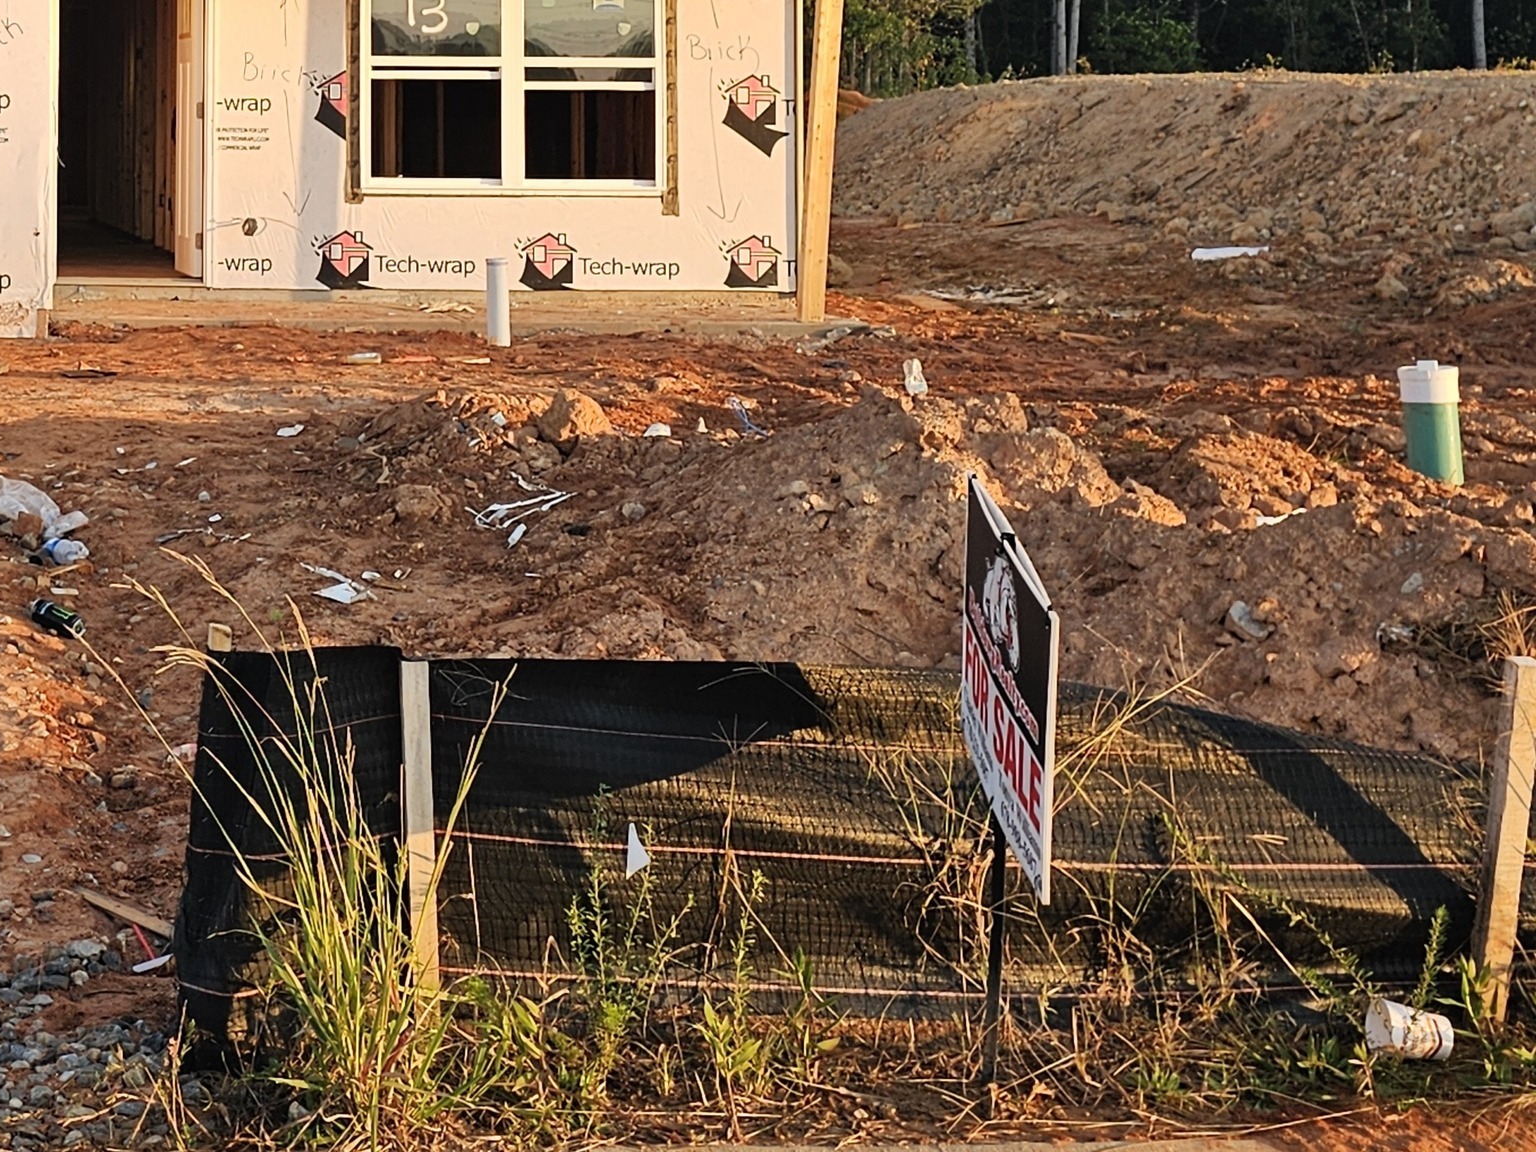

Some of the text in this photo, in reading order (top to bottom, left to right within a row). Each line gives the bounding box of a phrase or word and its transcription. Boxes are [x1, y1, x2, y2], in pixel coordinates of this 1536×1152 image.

[216, 98, 271, 116] -wrap
[218, 258, 272, 276] -wrap
[375, 255, 476, 278] Tech-wrap
[580, 257, 680, 280] Tech-wrap
[965, 624, 988, 735] FOR
[993, 695, 1041, 836] SALE
